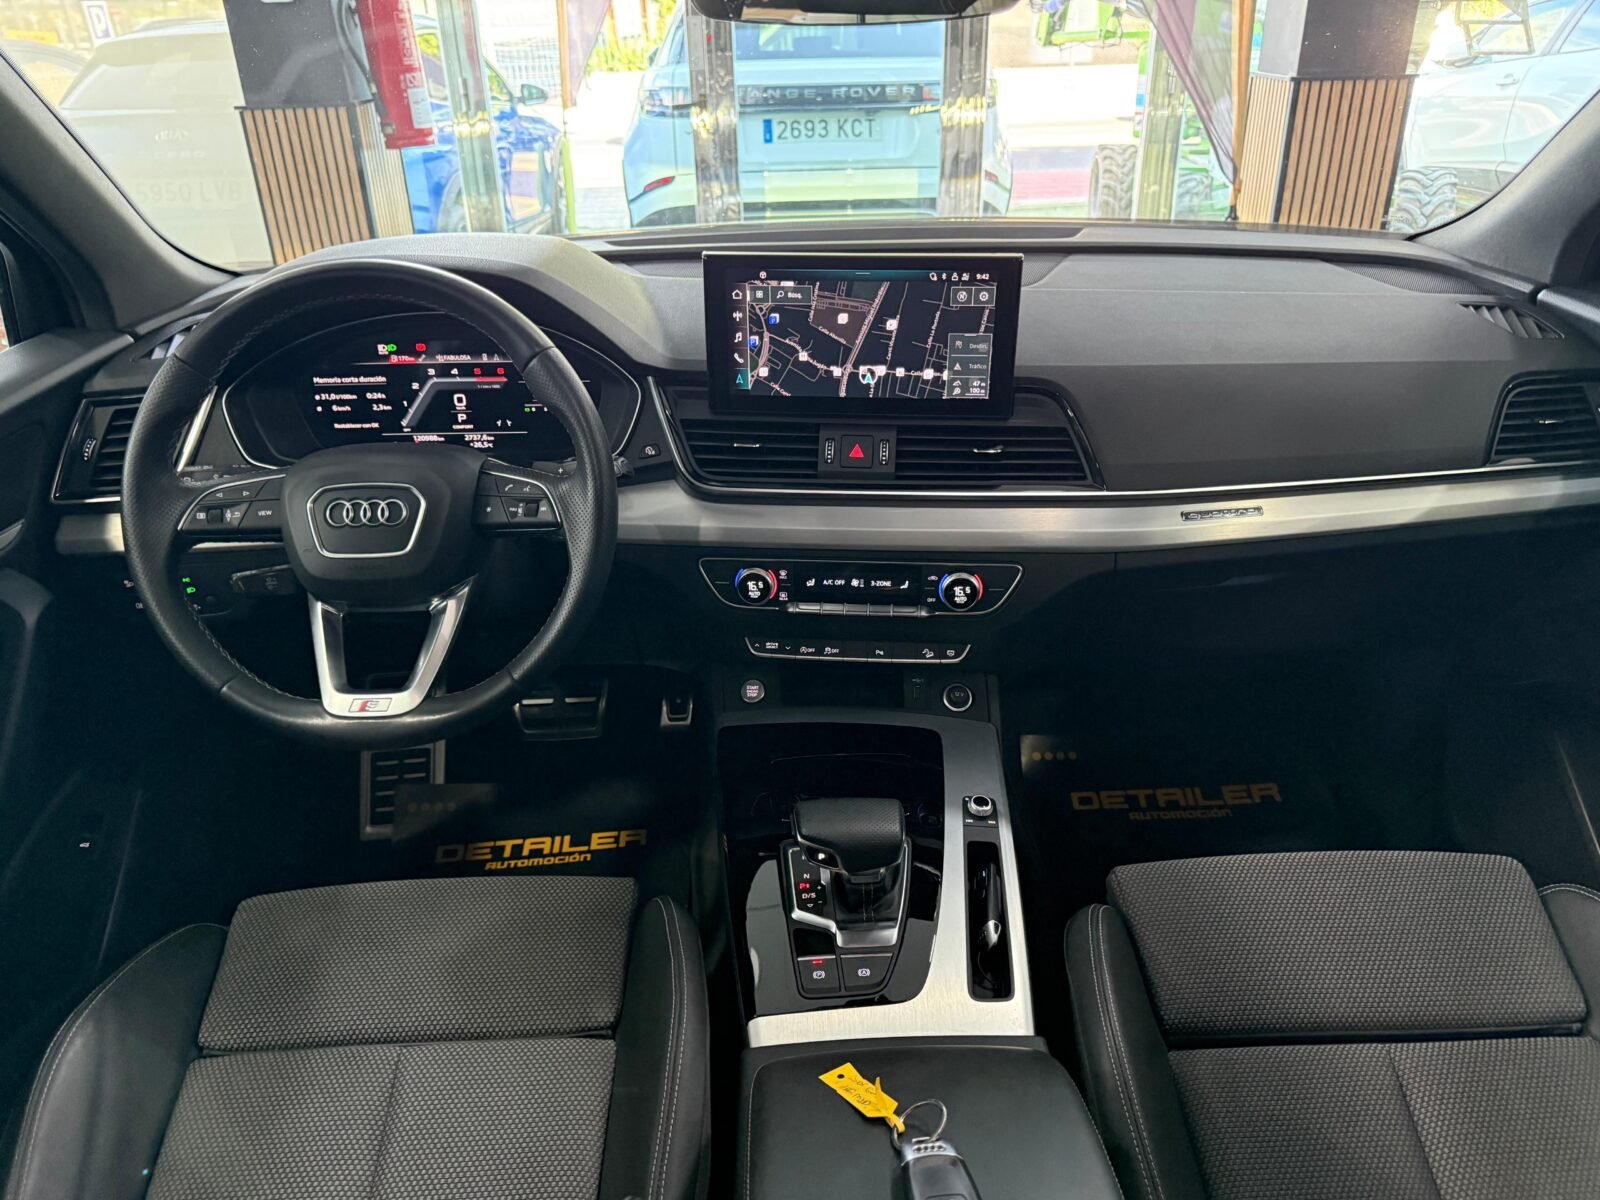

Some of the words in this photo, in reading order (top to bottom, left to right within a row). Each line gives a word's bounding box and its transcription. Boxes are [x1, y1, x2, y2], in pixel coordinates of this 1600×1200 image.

[832, 86, 916, 99] ROVER
[775, 119, 829, 140] 2693
[837, 118, 877, 139] KCT
[975, 273, 990, 281] 9:42
[457, 413, 467, 423] P
[1070, 782, 1283, 811] DETAILER
[435, 829, 648, 864] DETAILER
